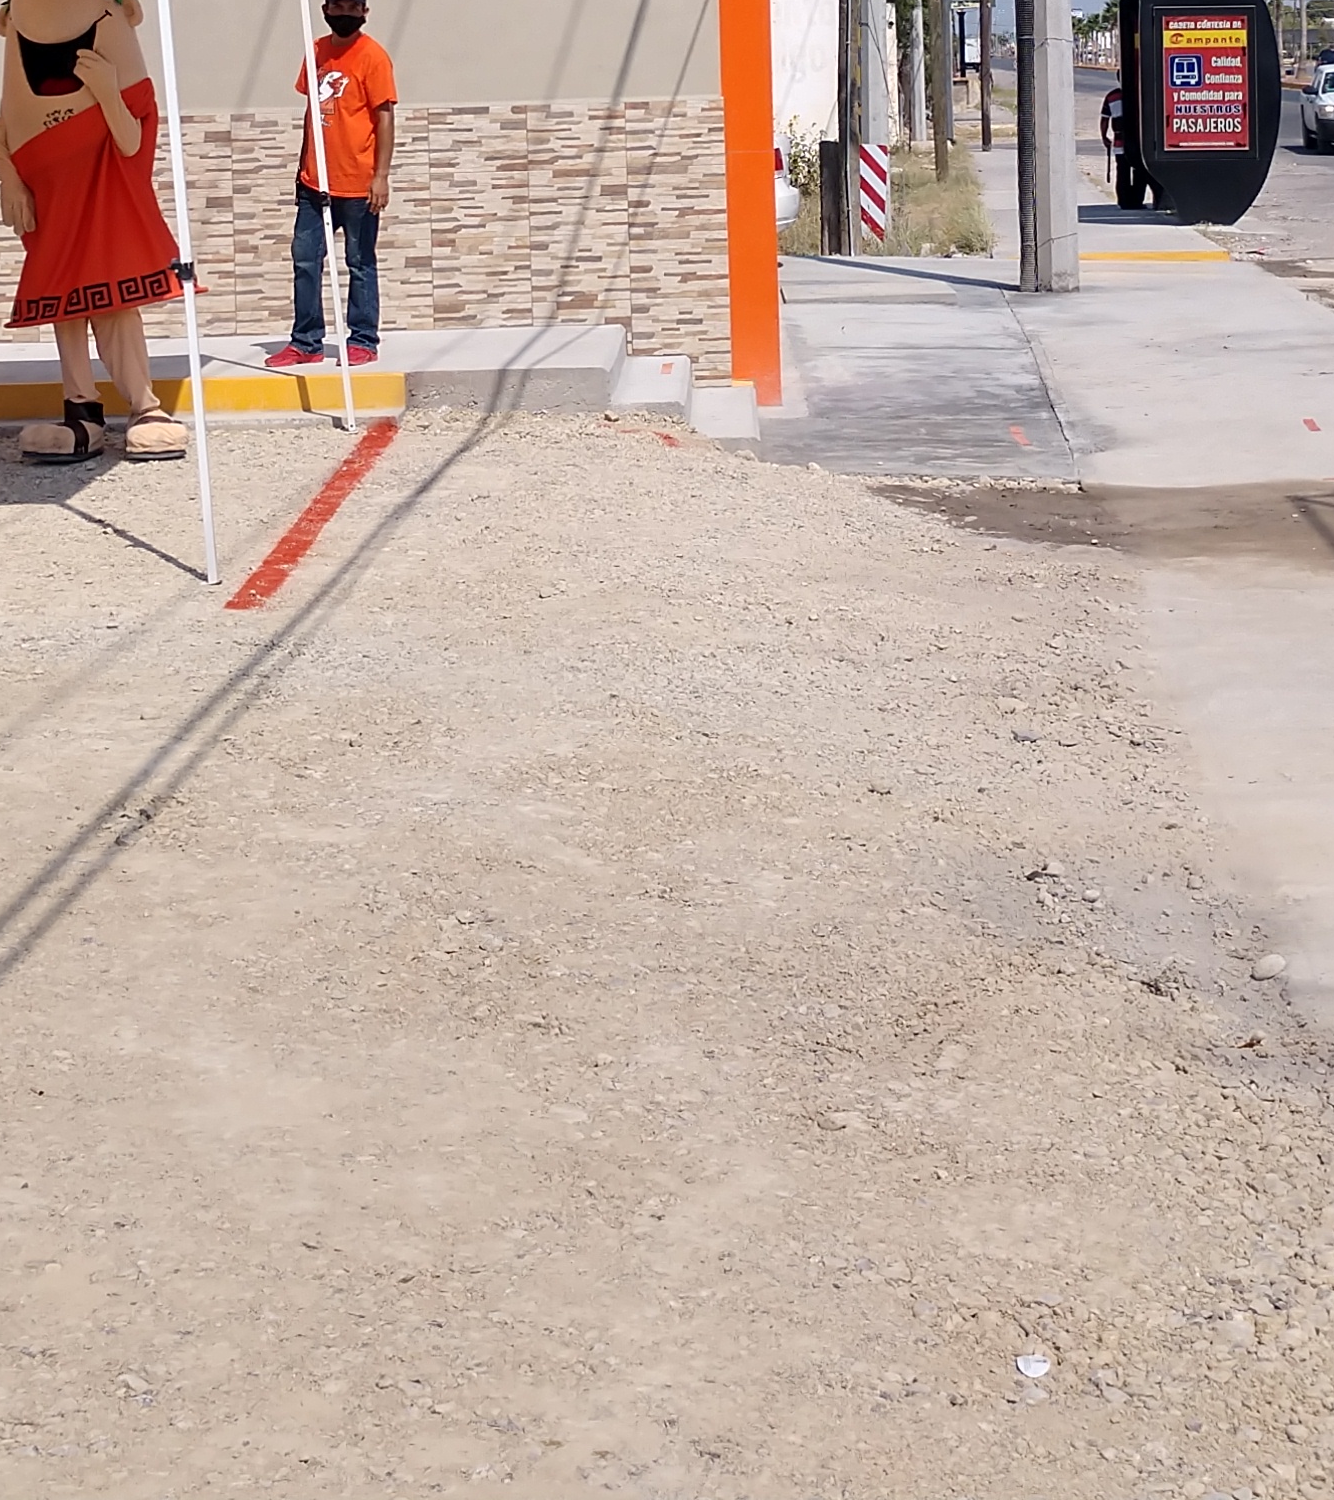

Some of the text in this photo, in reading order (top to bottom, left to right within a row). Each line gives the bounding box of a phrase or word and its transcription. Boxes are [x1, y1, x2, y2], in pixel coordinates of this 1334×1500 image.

[1211, 56, 1243, 67] Calidad,
[1205, 73, 1243, 84] Confianza
[1173, 90, 1243, 102] y Comodidad para
[1174, 104, 1241, 115] NUESTROS
[1173, 118, 1242, 133] PASAJEROS
